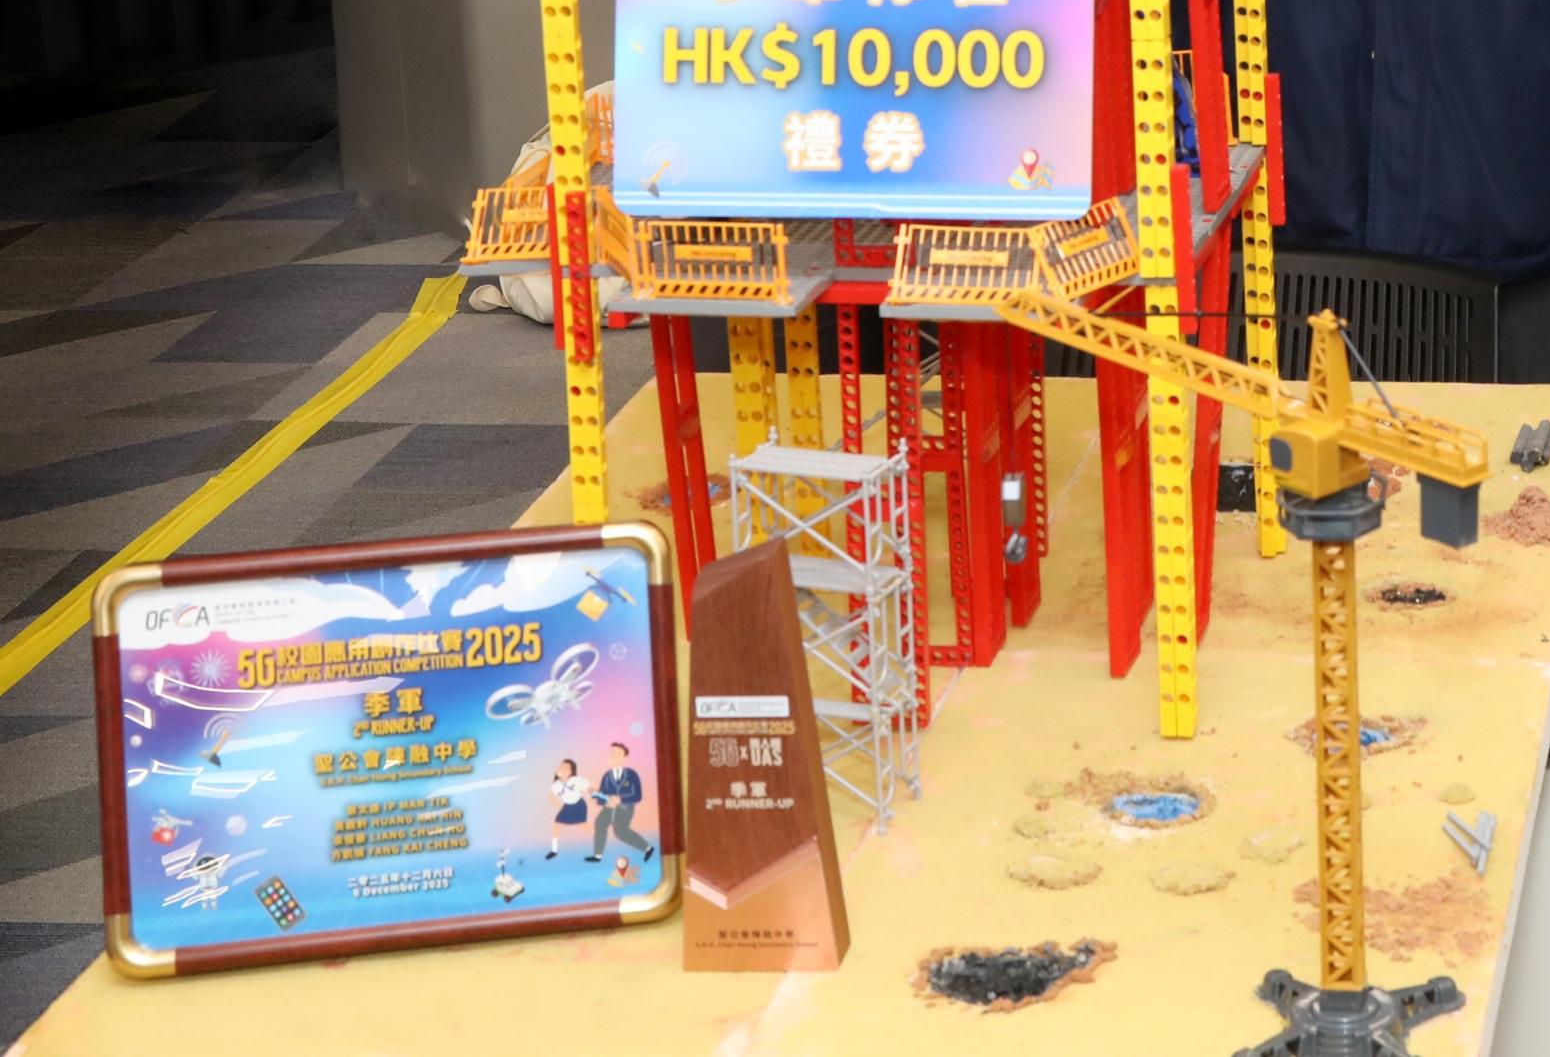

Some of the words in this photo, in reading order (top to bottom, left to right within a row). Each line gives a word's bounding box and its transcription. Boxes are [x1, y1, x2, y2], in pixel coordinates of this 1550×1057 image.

[662, 22, 1045, 96] HK$10,000
[783, 110, 925, 172] 禮券
[236, 647, 278, 690] 5G
[464, 621, 543, 668] 2025
[324, 658, 392, 681] APPLICATION
[393, 652, 464, 675] COMPETITION
